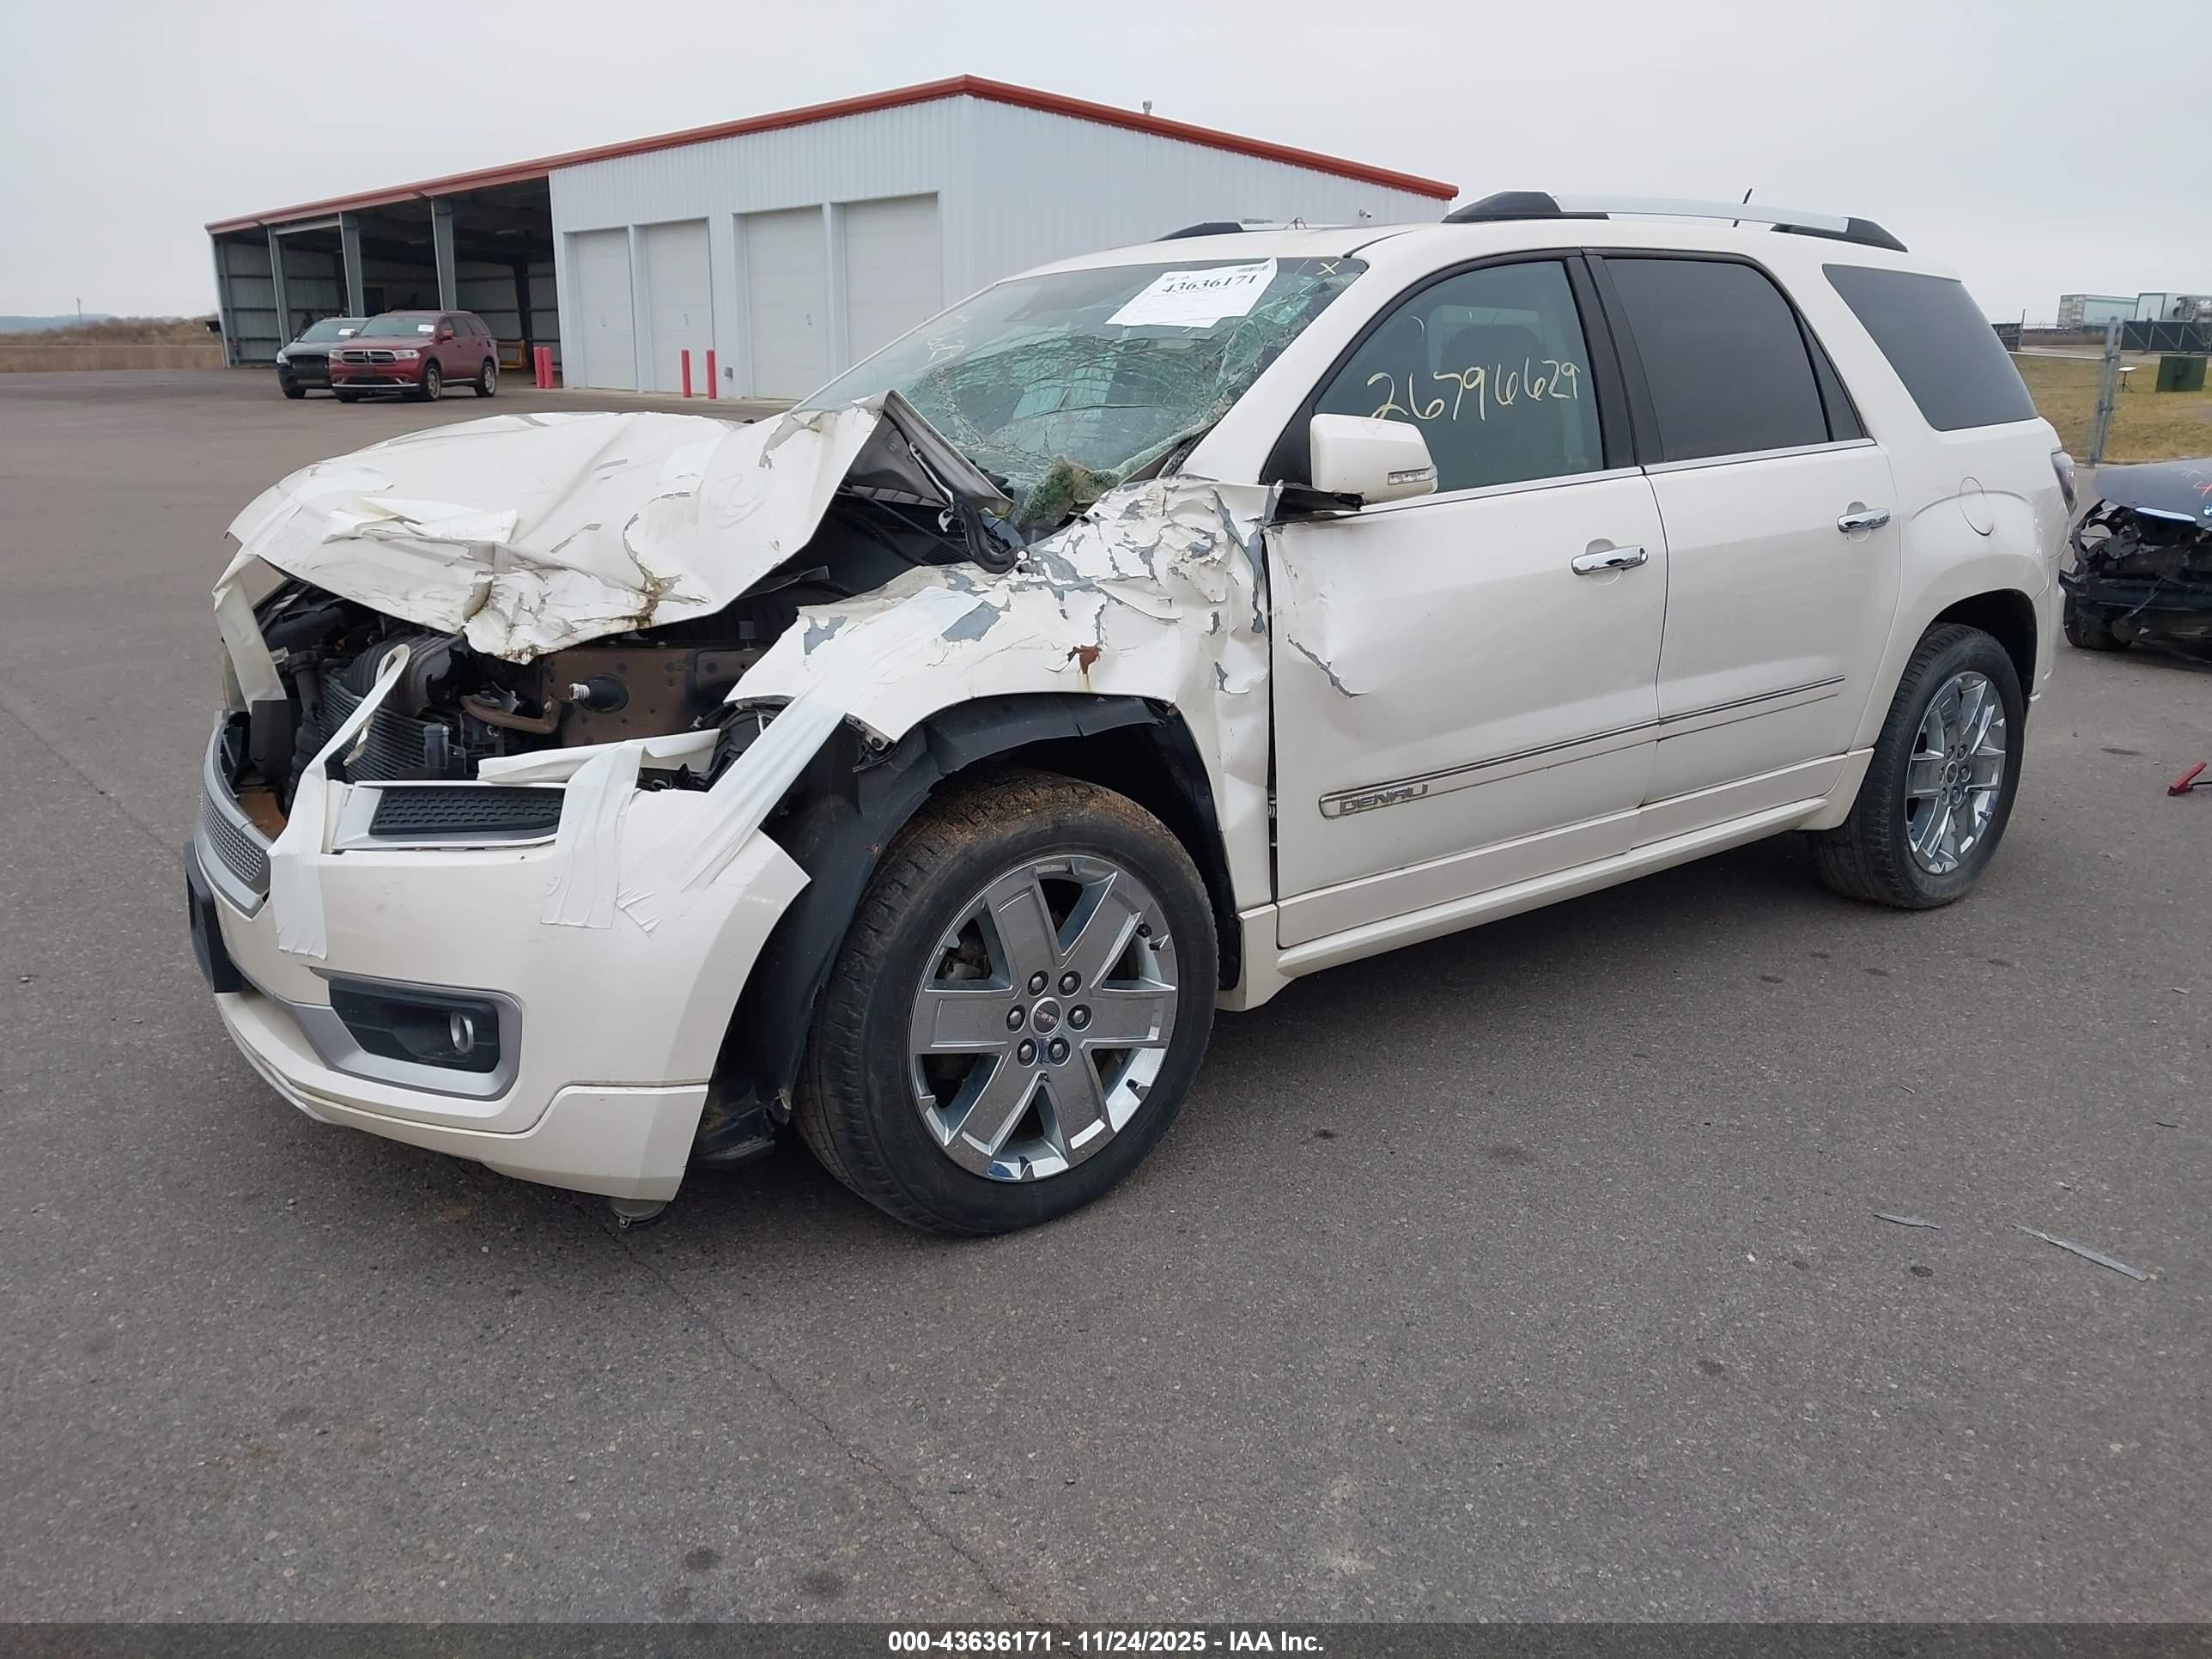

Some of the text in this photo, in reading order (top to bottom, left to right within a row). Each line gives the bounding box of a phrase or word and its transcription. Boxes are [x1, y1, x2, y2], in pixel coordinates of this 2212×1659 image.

[1161, 274, 1258, 293] 43636171
[1366, 356, 1580, 421] 26796629
[1340, 784, 1429, 813] DENALI
